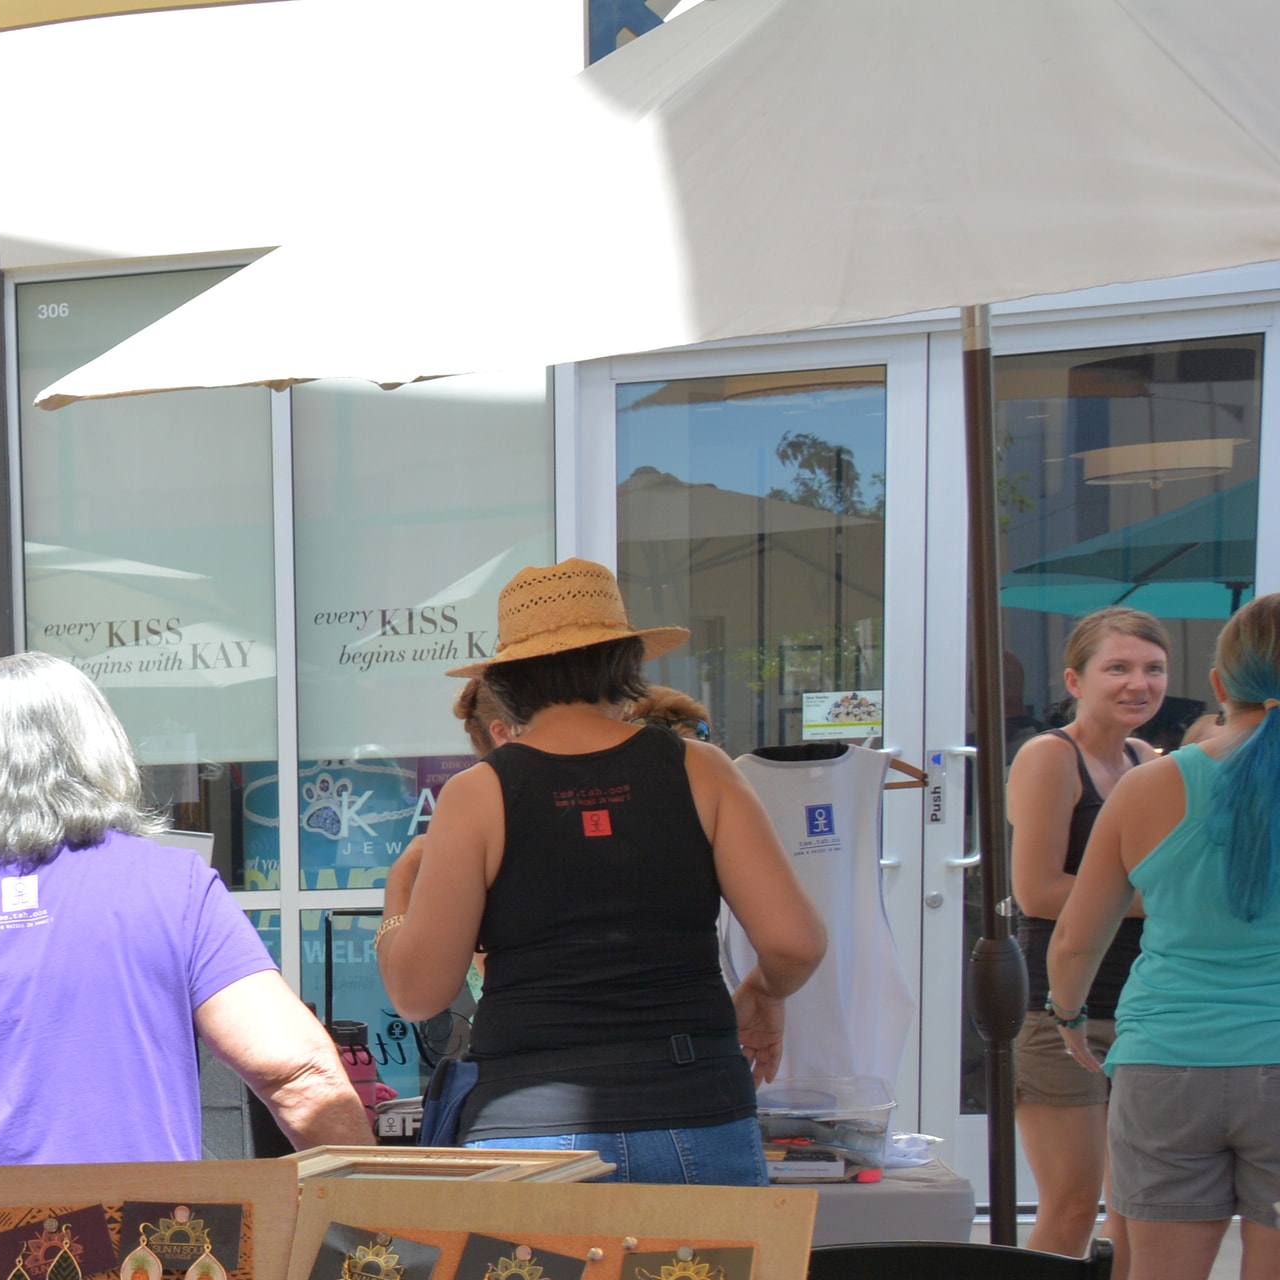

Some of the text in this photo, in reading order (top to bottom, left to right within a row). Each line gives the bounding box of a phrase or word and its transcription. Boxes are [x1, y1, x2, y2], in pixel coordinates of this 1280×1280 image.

[37, 302, 70, 319] 306
[44, 618, 184, 649] every KISS
[314, 605, 460, 637] every KISS
[69, 640, 257, 682] begins with KAY
[338, 644, 410, 677] begins
[413, 640, 459, 662] with
[931, 786, 942, 822] Push
[152, 1246, 171, 1255] SUN
[173, 1246, 181, 1255] N
